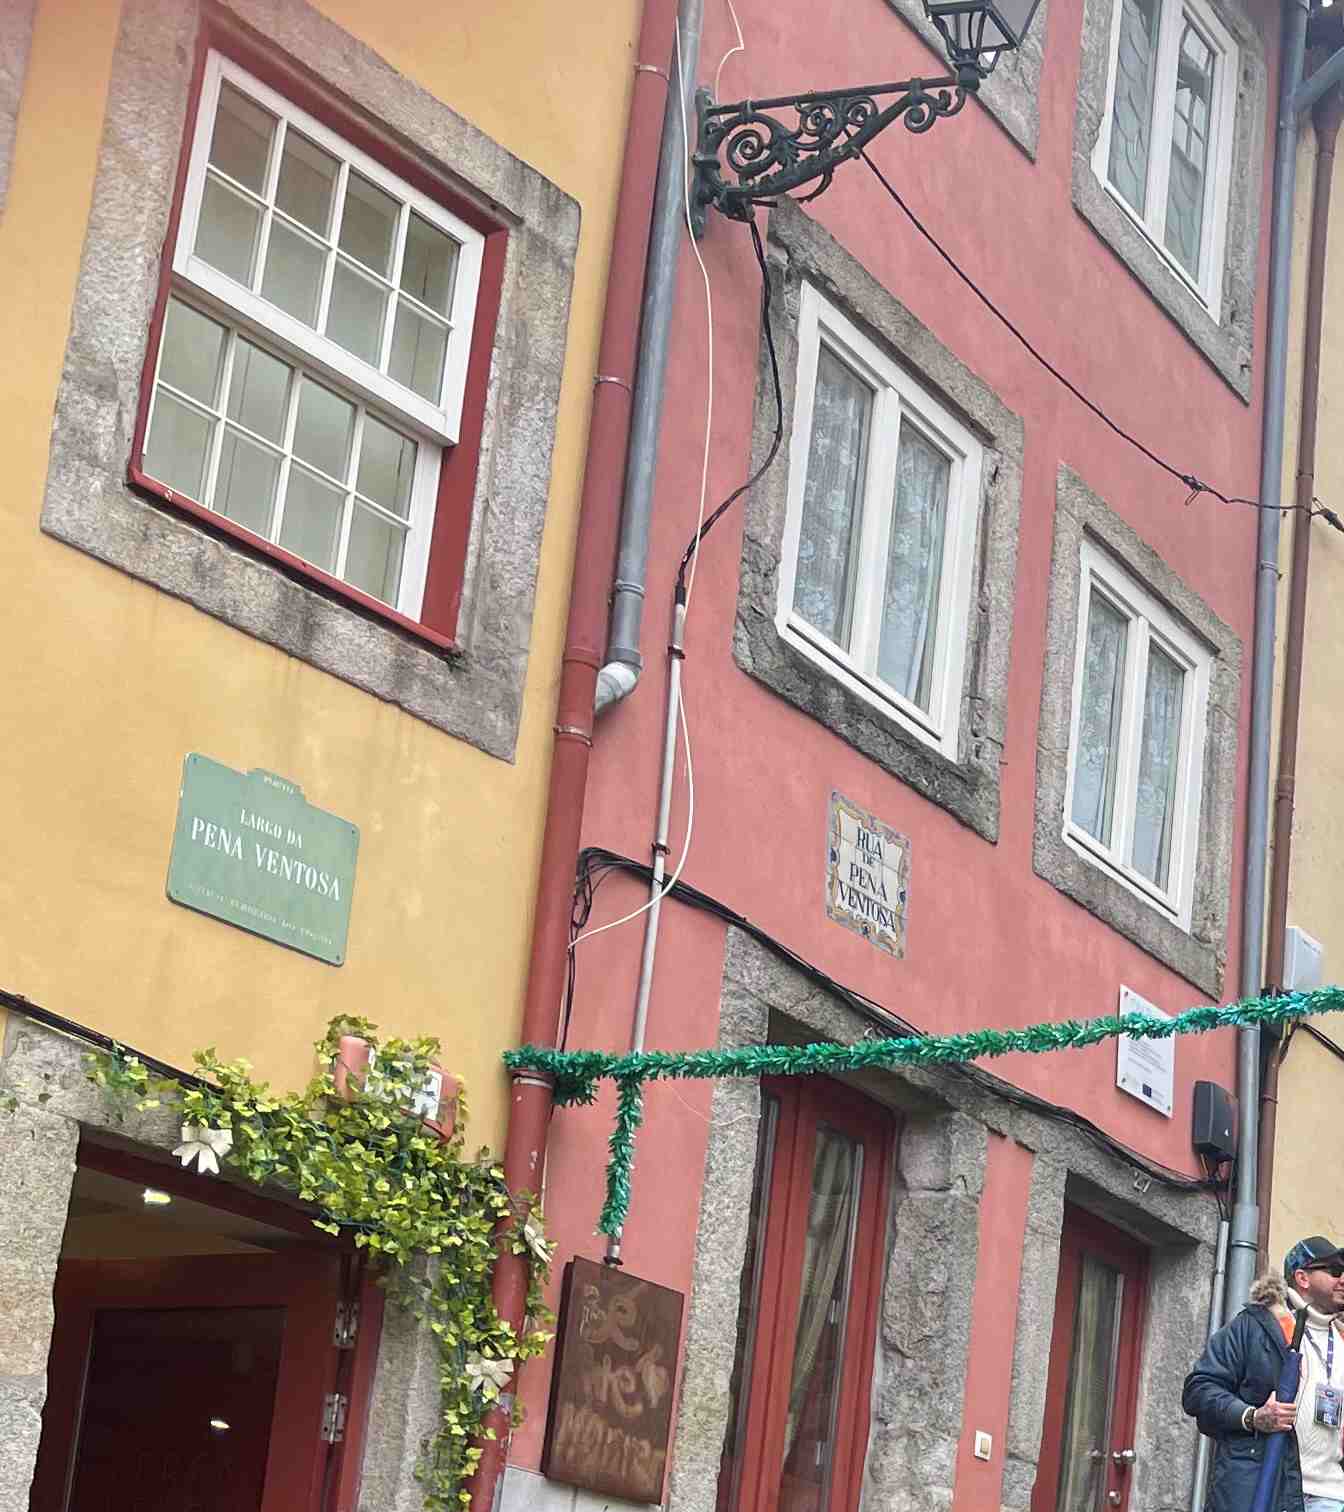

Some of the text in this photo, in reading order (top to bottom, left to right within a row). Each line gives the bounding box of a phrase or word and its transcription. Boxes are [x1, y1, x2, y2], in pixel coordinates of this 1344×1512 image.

[240, 808, 304, 849] LARGO DA
[857, 826, 883, 859] RUA
[191, 816, 341, 901] PENA VENTOSA
[849, 862, 888, 902] PENA
[838, 879, 896, 933] VENTOSA
